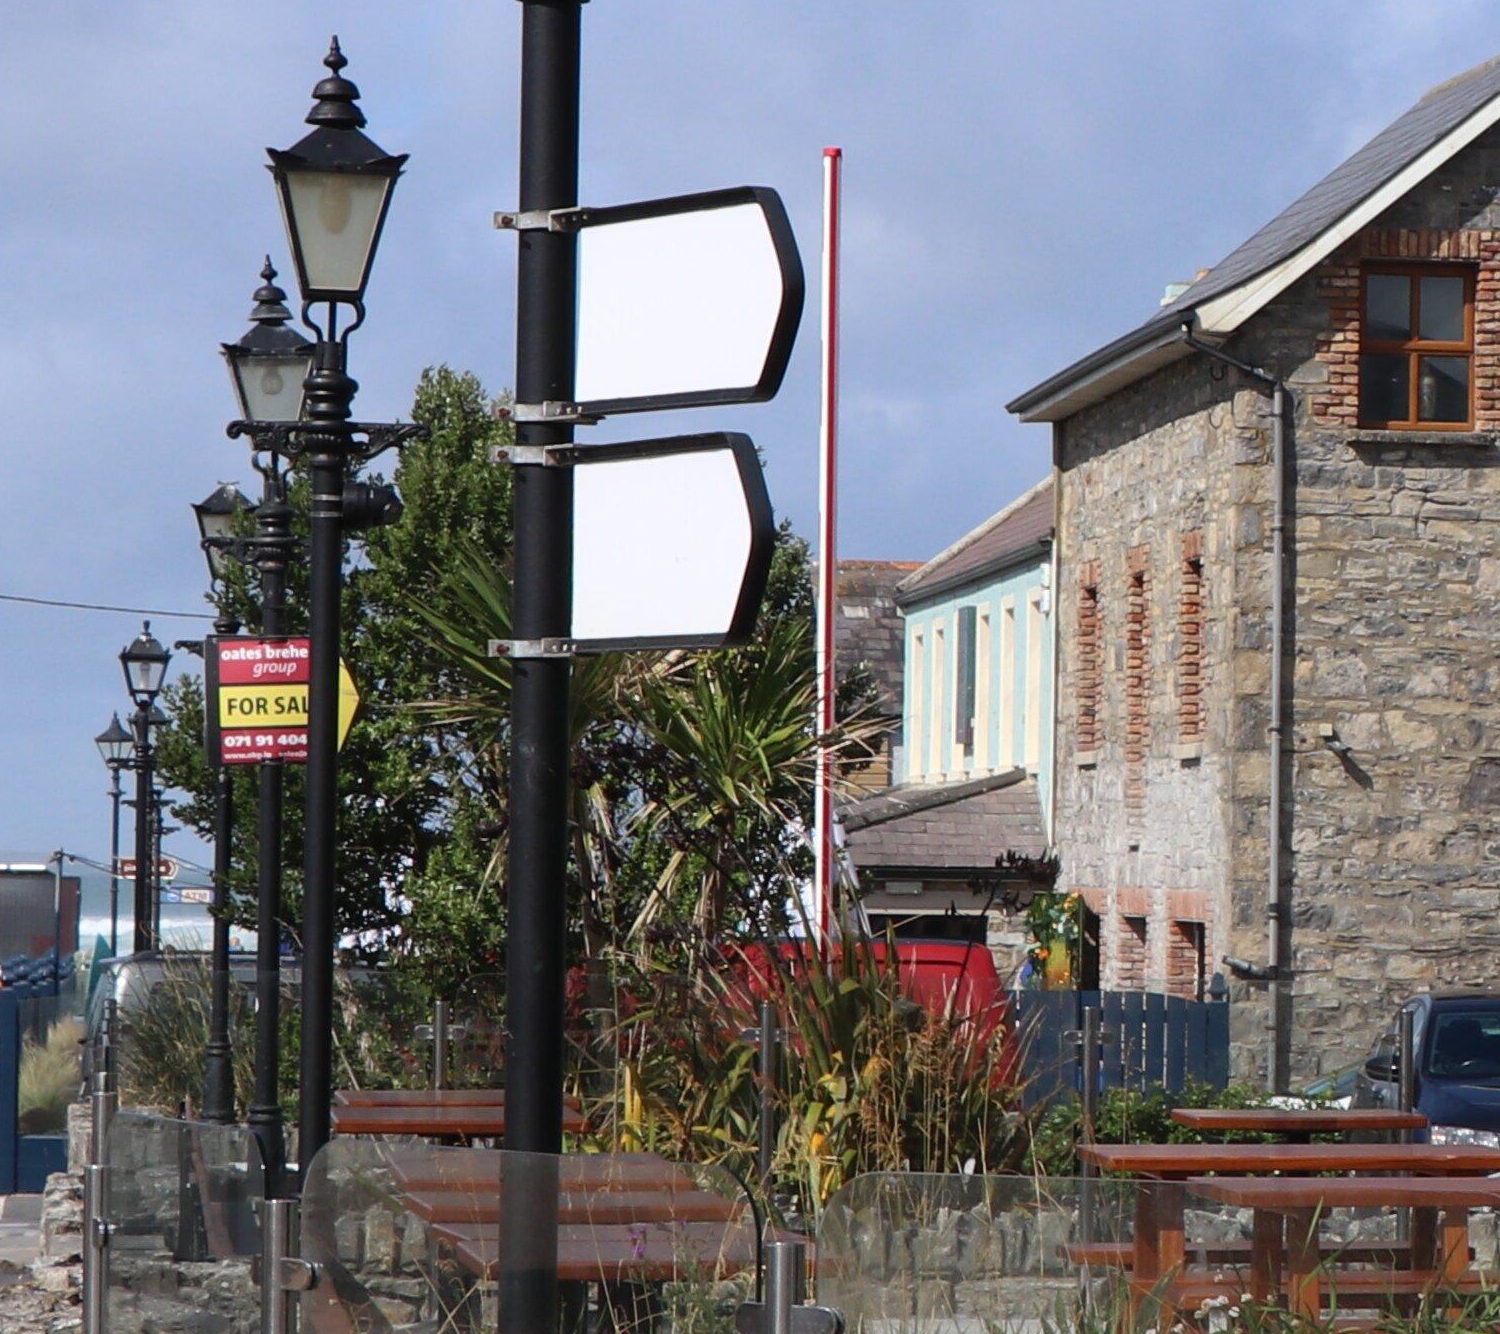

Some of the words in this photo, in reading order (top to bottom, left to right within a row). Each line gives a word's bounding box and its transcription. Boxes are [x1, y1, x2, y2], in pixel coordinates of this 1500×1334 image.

[221, 646, 263, 661] oates
[252, 661, 297, 678] group
[227, 697, 269, 716] FOR
[224, 735, 252, 748] 071
[255, 734, 275, 746] 91
